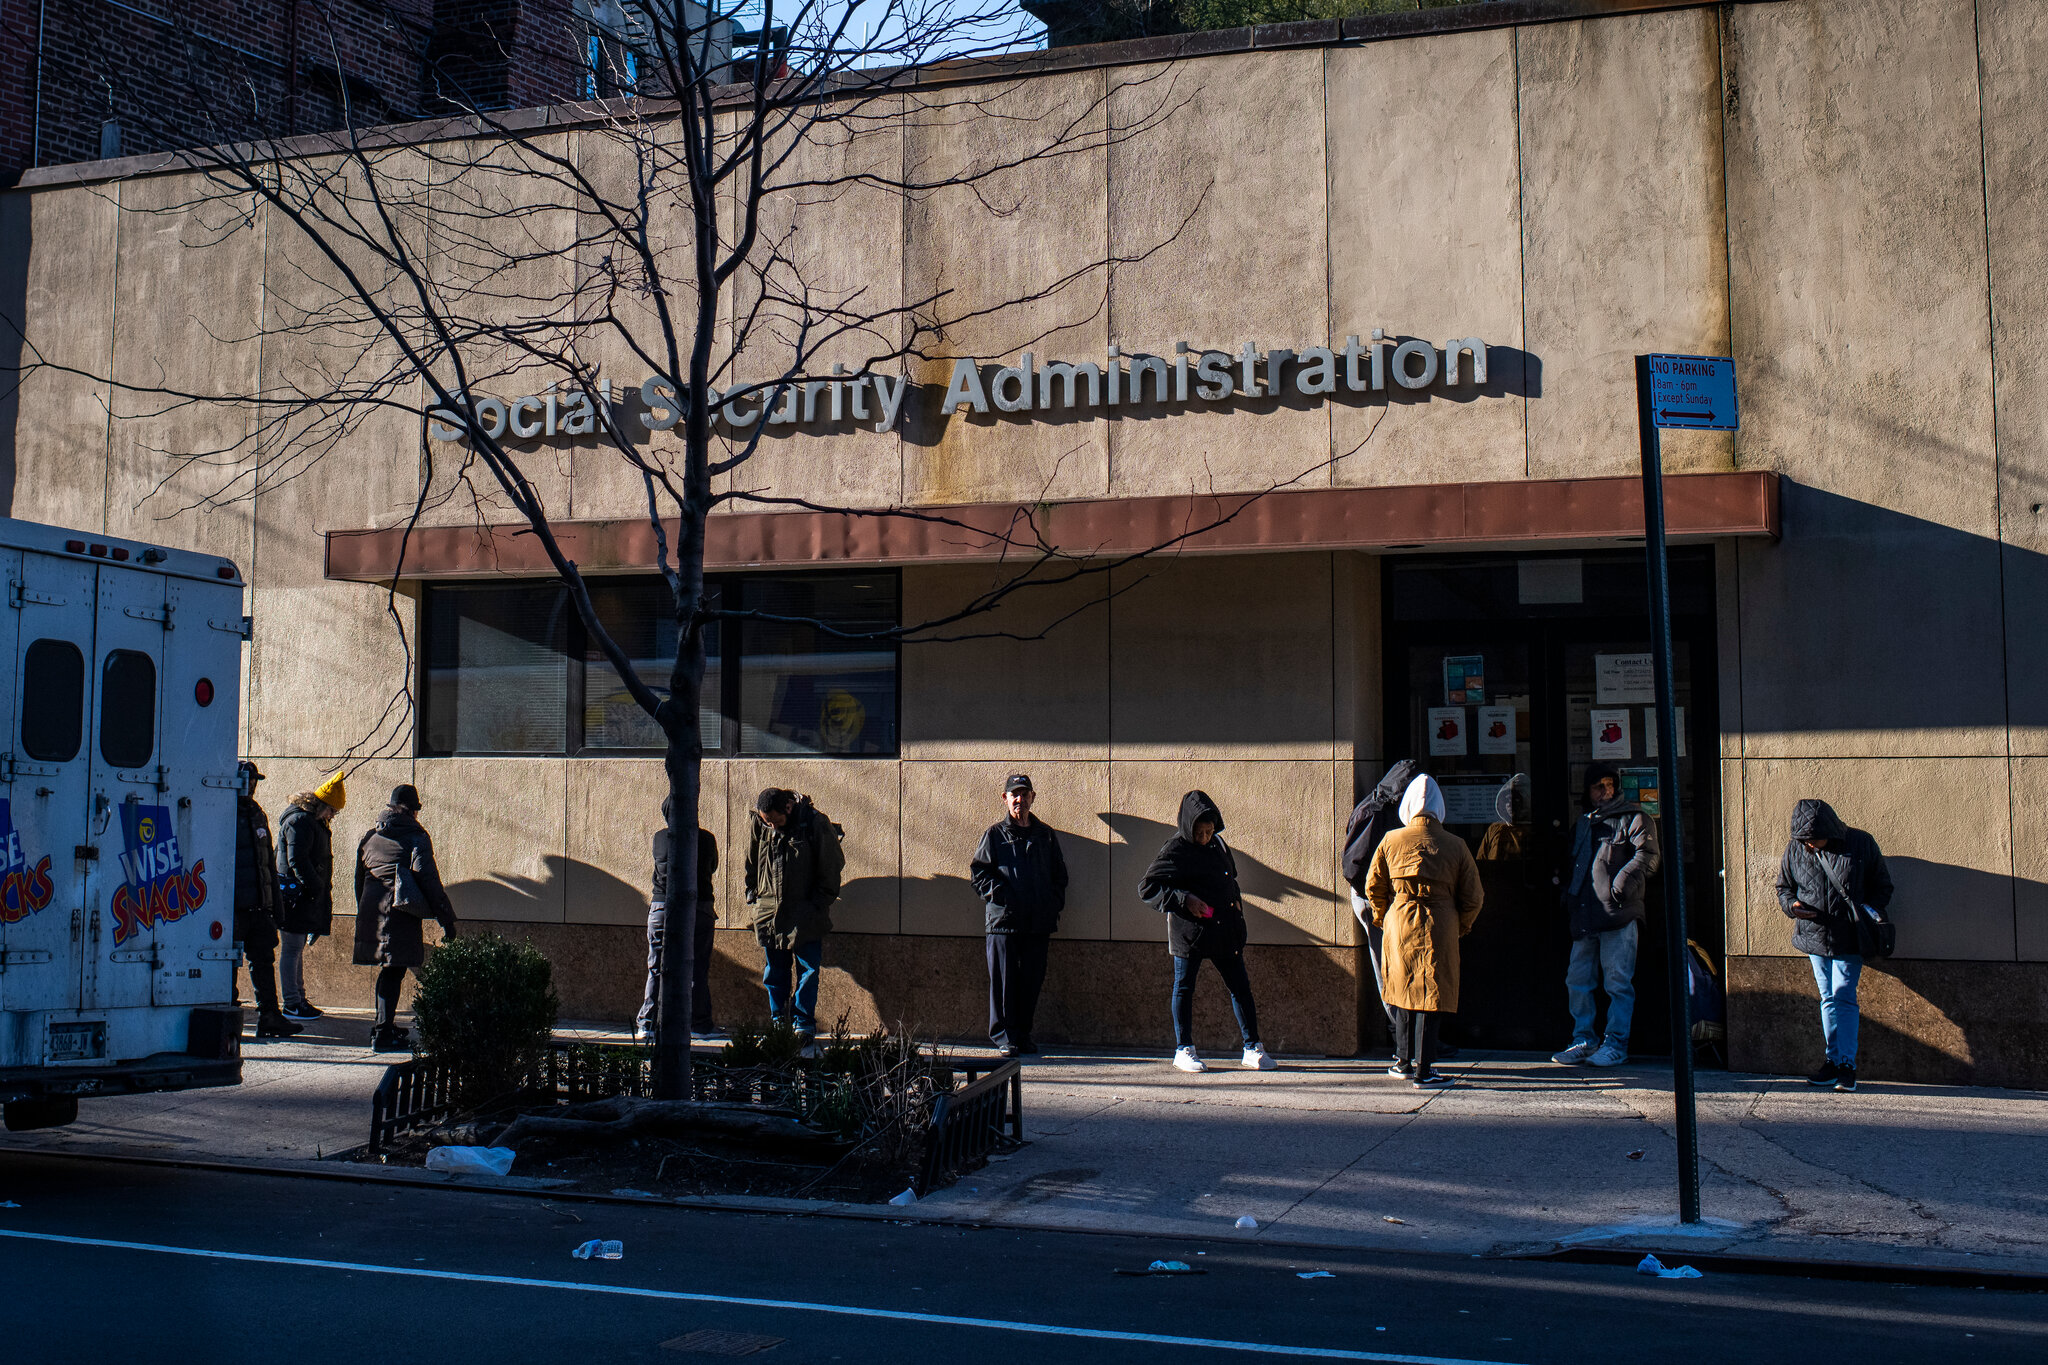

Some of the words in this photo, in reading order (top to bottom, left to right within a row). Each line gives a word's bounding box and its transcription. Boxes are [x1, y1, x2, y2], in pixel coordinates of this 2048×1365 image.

[941, 329, 1487, 414] Administration
[1655, 362, 1669, 374] NO
[1672, 362, 1715, 377] PARKING
[1656, 379, 1673, 389] 8am
[1680, 380, 1697, 392] 6pm
[1657, 392, 1683, 405] Except
[1685, 393, 1713, 406] Sunday
[119, 836, 182, 886] WISE
[0, 855, 53, 922] CKS
[112, 859, 207, 946] SNACKS
